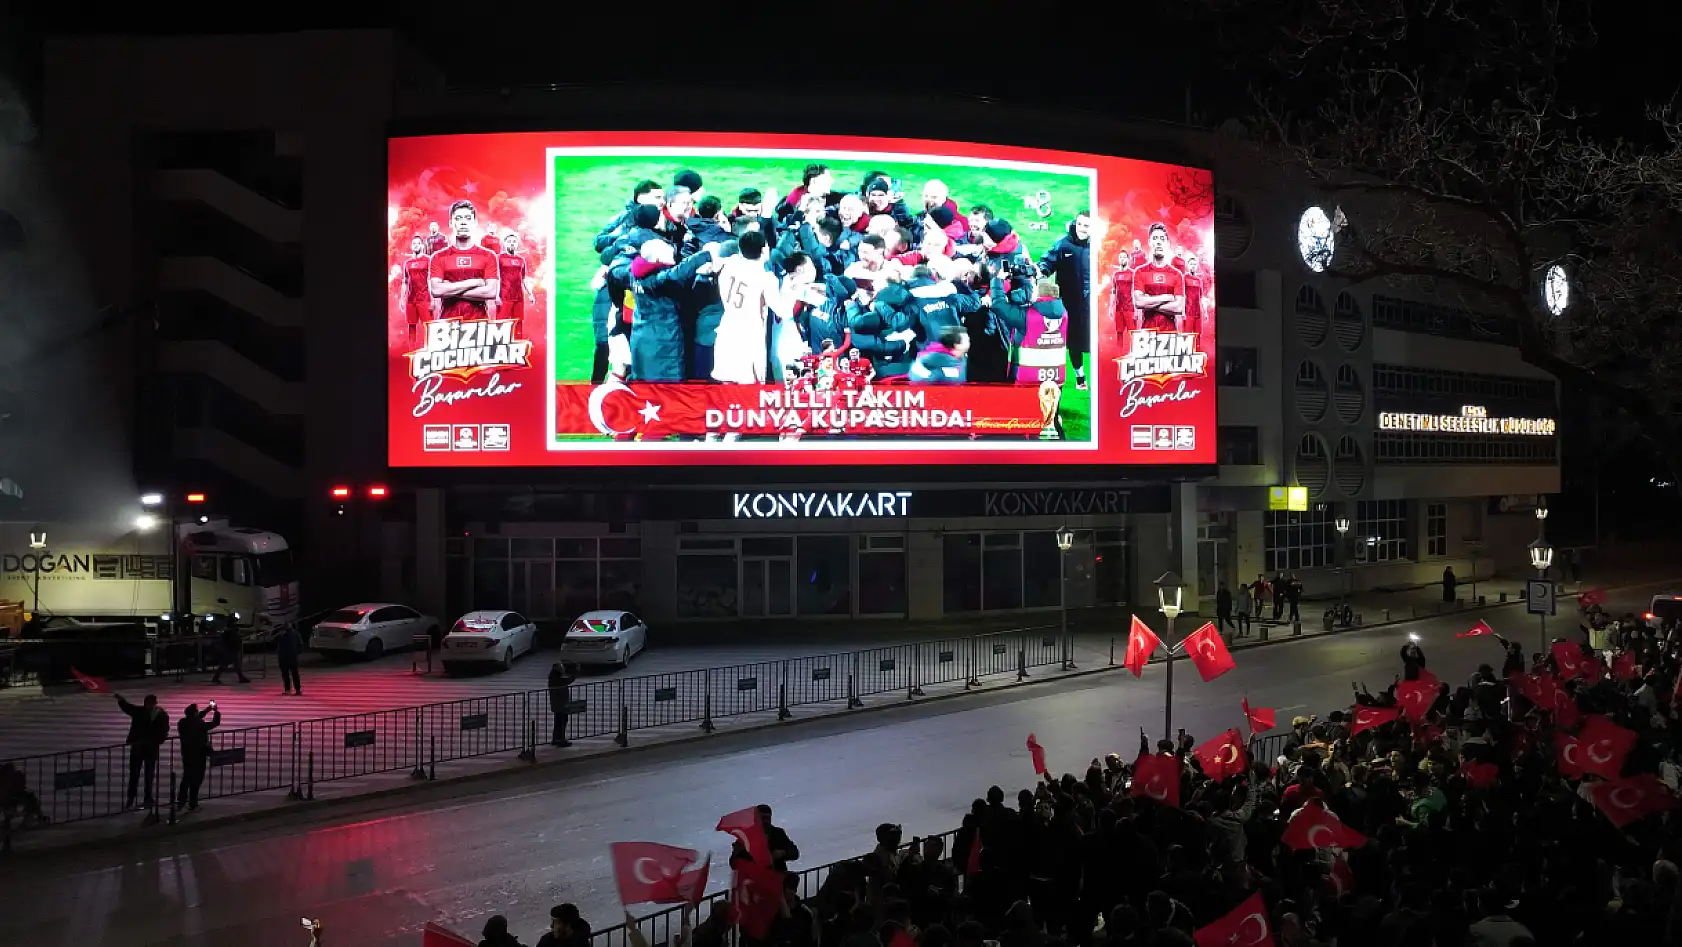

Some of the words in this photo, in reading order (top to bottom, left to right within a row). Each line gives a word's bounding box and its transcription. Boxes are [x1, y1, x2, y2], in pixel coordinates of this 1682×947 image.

[727, 276, 748, 309] 15
[843, 389, 925, 408] TAKIM
[706, 403, 803, 428] DÜNYA
[811, 409, 972, 428] KUPASINDA!
[734, 492, 913, 518] KONYAKART
[985, 490, 1131, 516] KONYAKART
